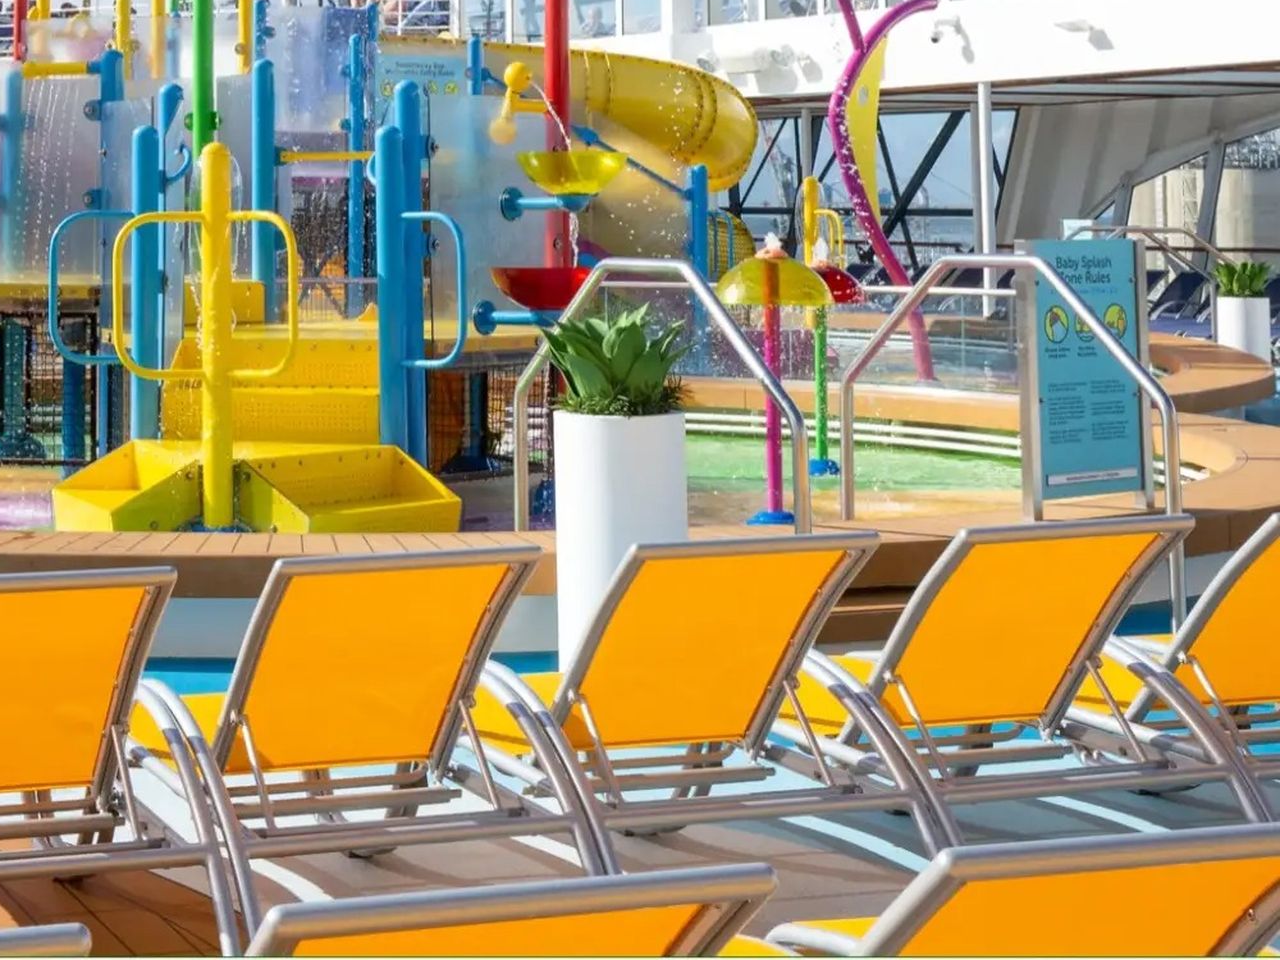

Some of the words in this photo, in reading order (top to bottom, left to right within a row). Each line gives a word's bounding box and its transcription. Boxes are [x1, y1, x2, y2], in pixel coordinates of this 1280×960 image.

[1056, 256, 1079, 271] Baby
[1081, 255, 1112, 269] Splash
[1085, 270, 1111, 283] Rules
